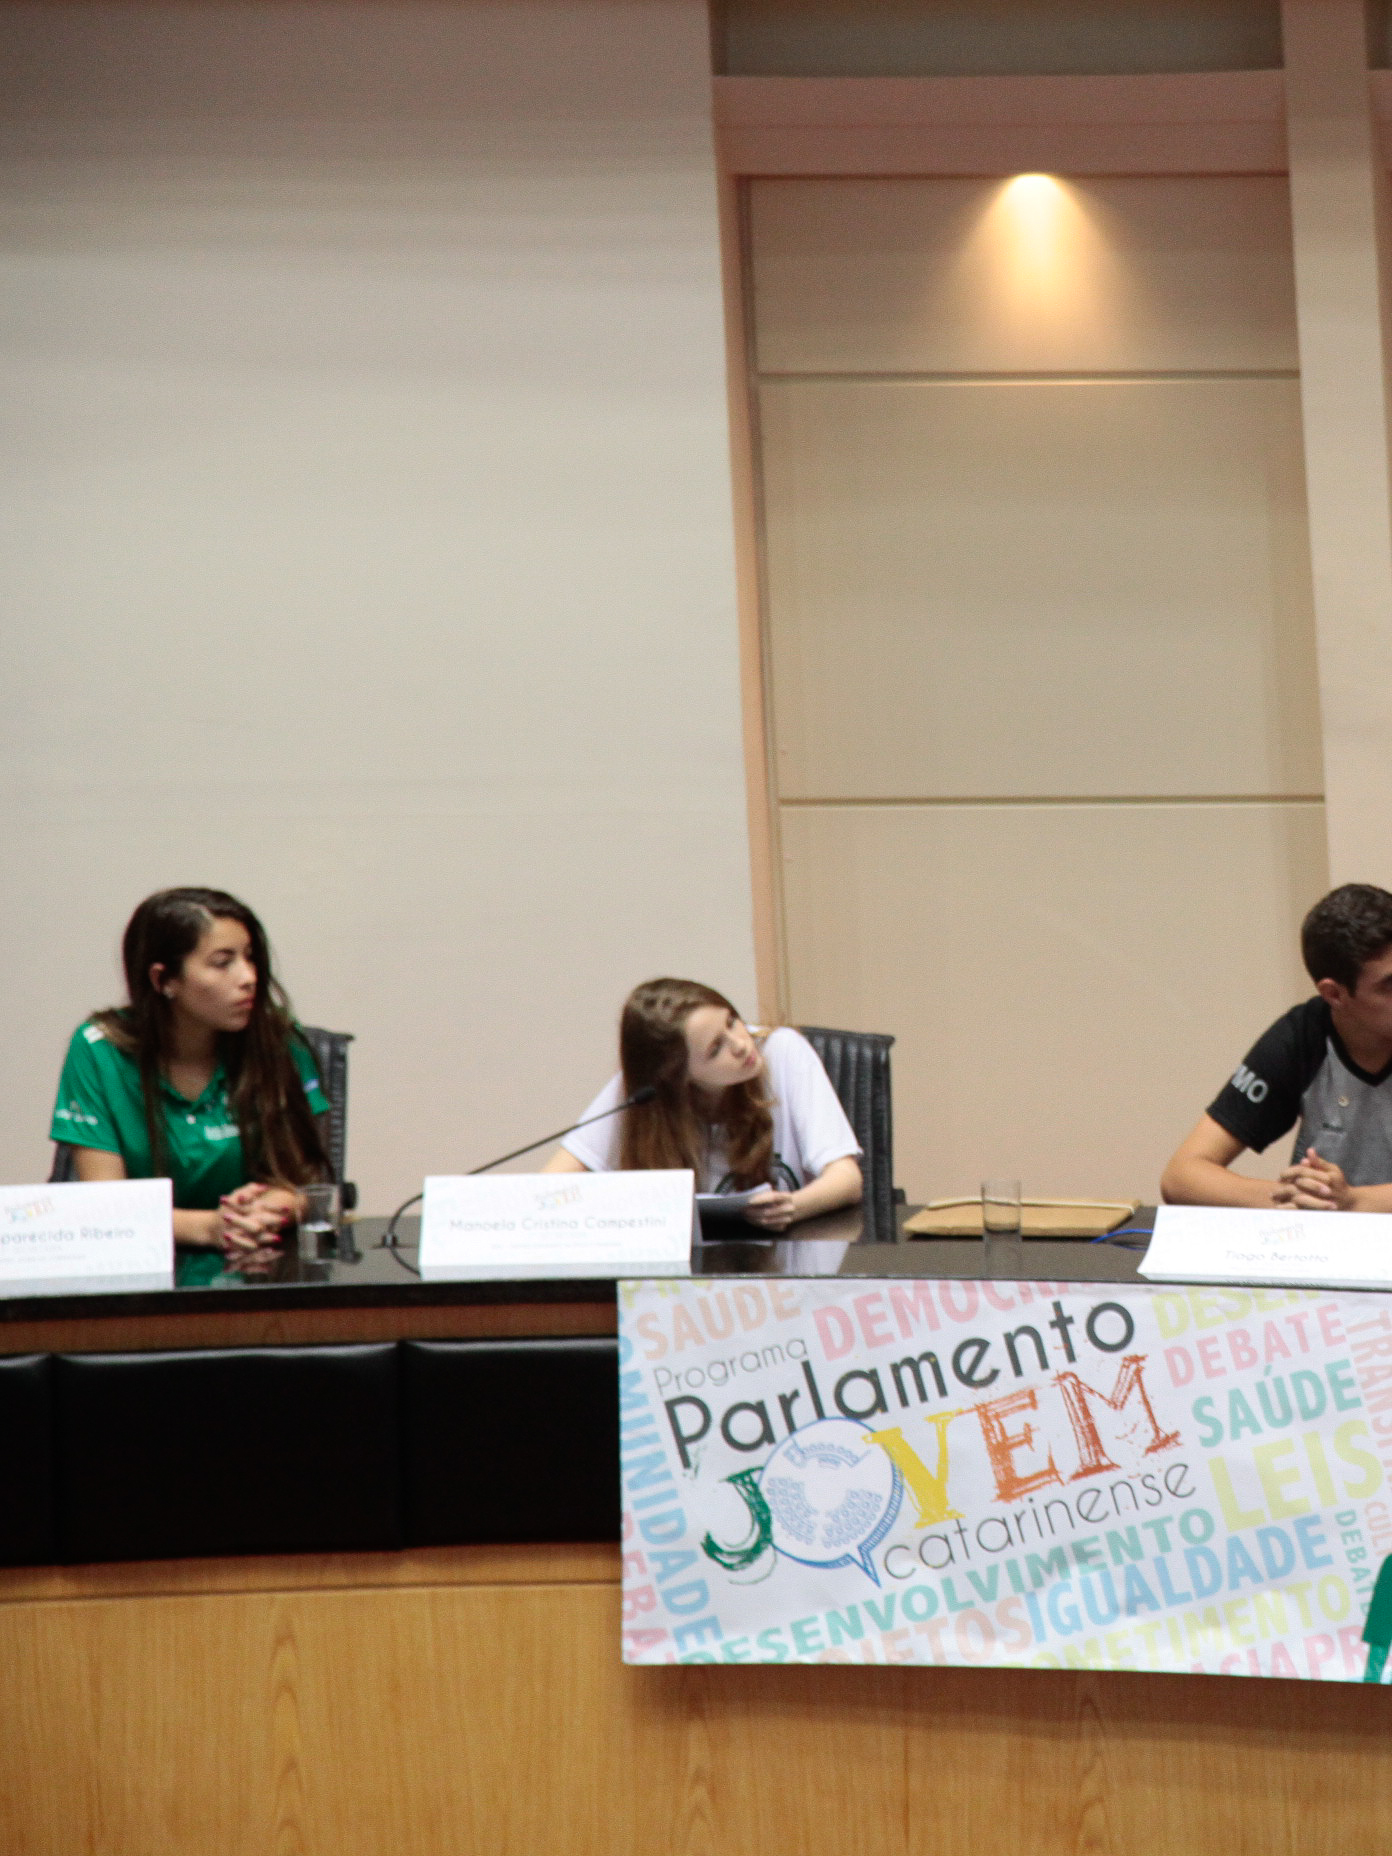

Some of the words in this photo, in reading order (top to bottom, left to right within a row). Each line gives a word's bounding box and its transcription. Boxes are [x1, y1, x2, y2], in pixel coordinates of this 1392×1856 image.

[653, 1338, 808, 1397] Programa
[664, 1300, 1135, 1469] Parlamento
[1163, 1303, 1347, 1388] DEBATE
[1192, 1359, 1363, 1448] SAÚDE
[883, 1462, 1197, 1580] catarinense
[1208, 1419, 1384, 1533] LEIS
[1023, 1513, 1334, 1644] IGUALDADE
